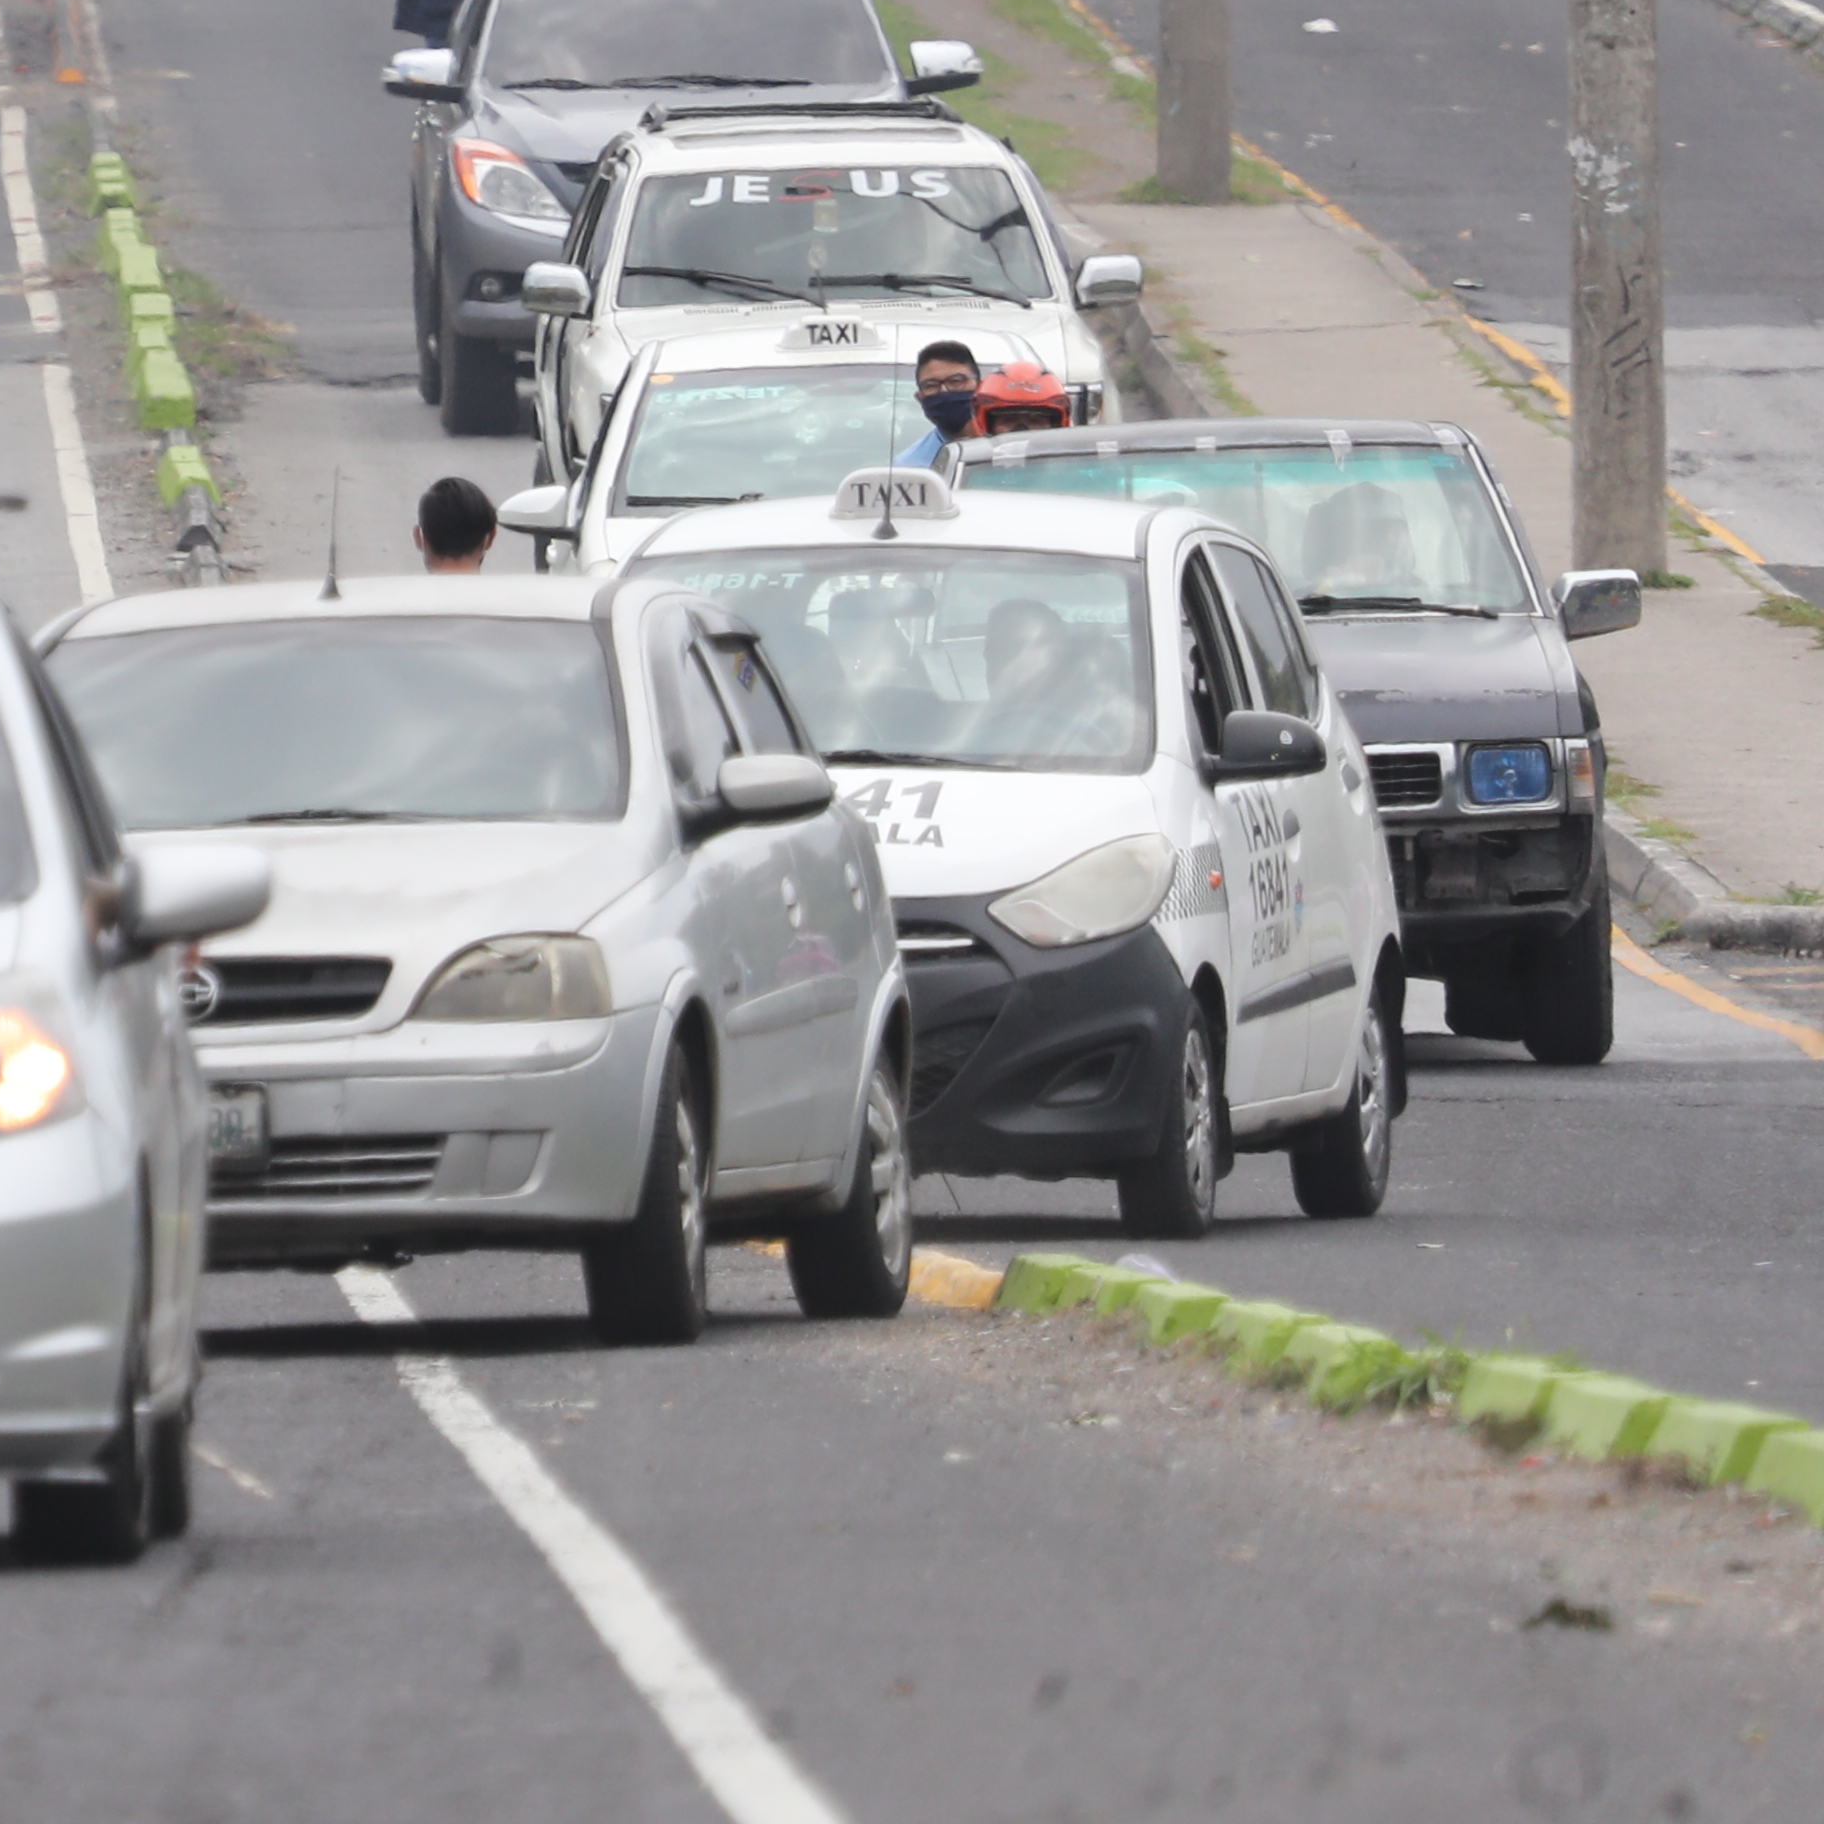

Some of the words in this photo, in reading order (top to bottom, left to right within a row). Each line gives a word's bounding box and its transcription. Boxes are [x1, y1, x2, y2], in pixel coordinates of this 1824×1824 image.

[689, 169, 952, 207] JESUS
[805, 323, 859, 345] TAXI
[850, 481, 928, 508] TAXI
[1228, 781, 1284, 854] TAXI
[1248, 851, 1292, 923] 16841
